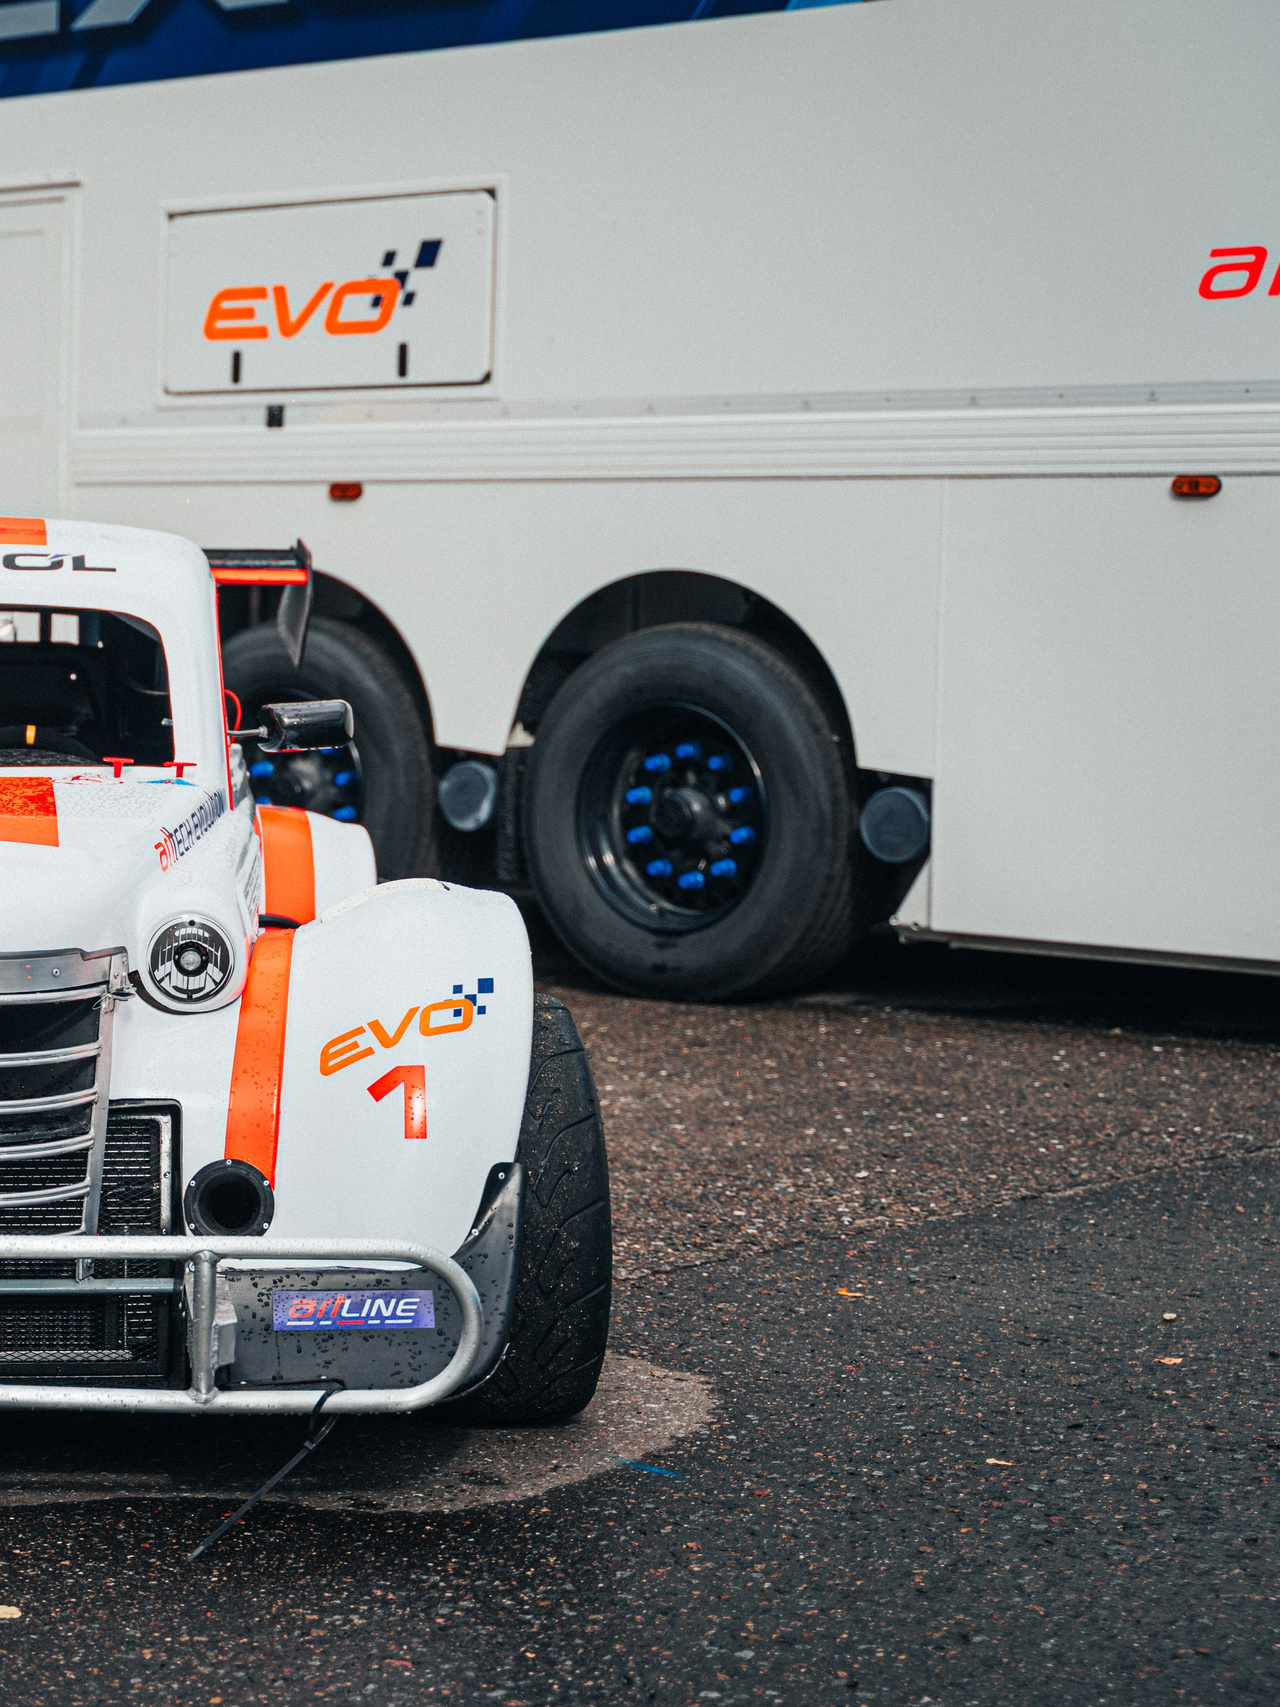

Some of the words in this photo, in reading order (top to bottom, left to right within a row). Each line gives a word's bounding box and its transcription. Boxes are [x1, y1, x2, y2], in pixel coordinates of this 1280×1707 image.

[203, 277, 401, 341] EVO
[319, 998, 474, 1076] EVO
[366, 1065, 427, 1139] 1
[289, 1294, 420, 1318] artLINE
